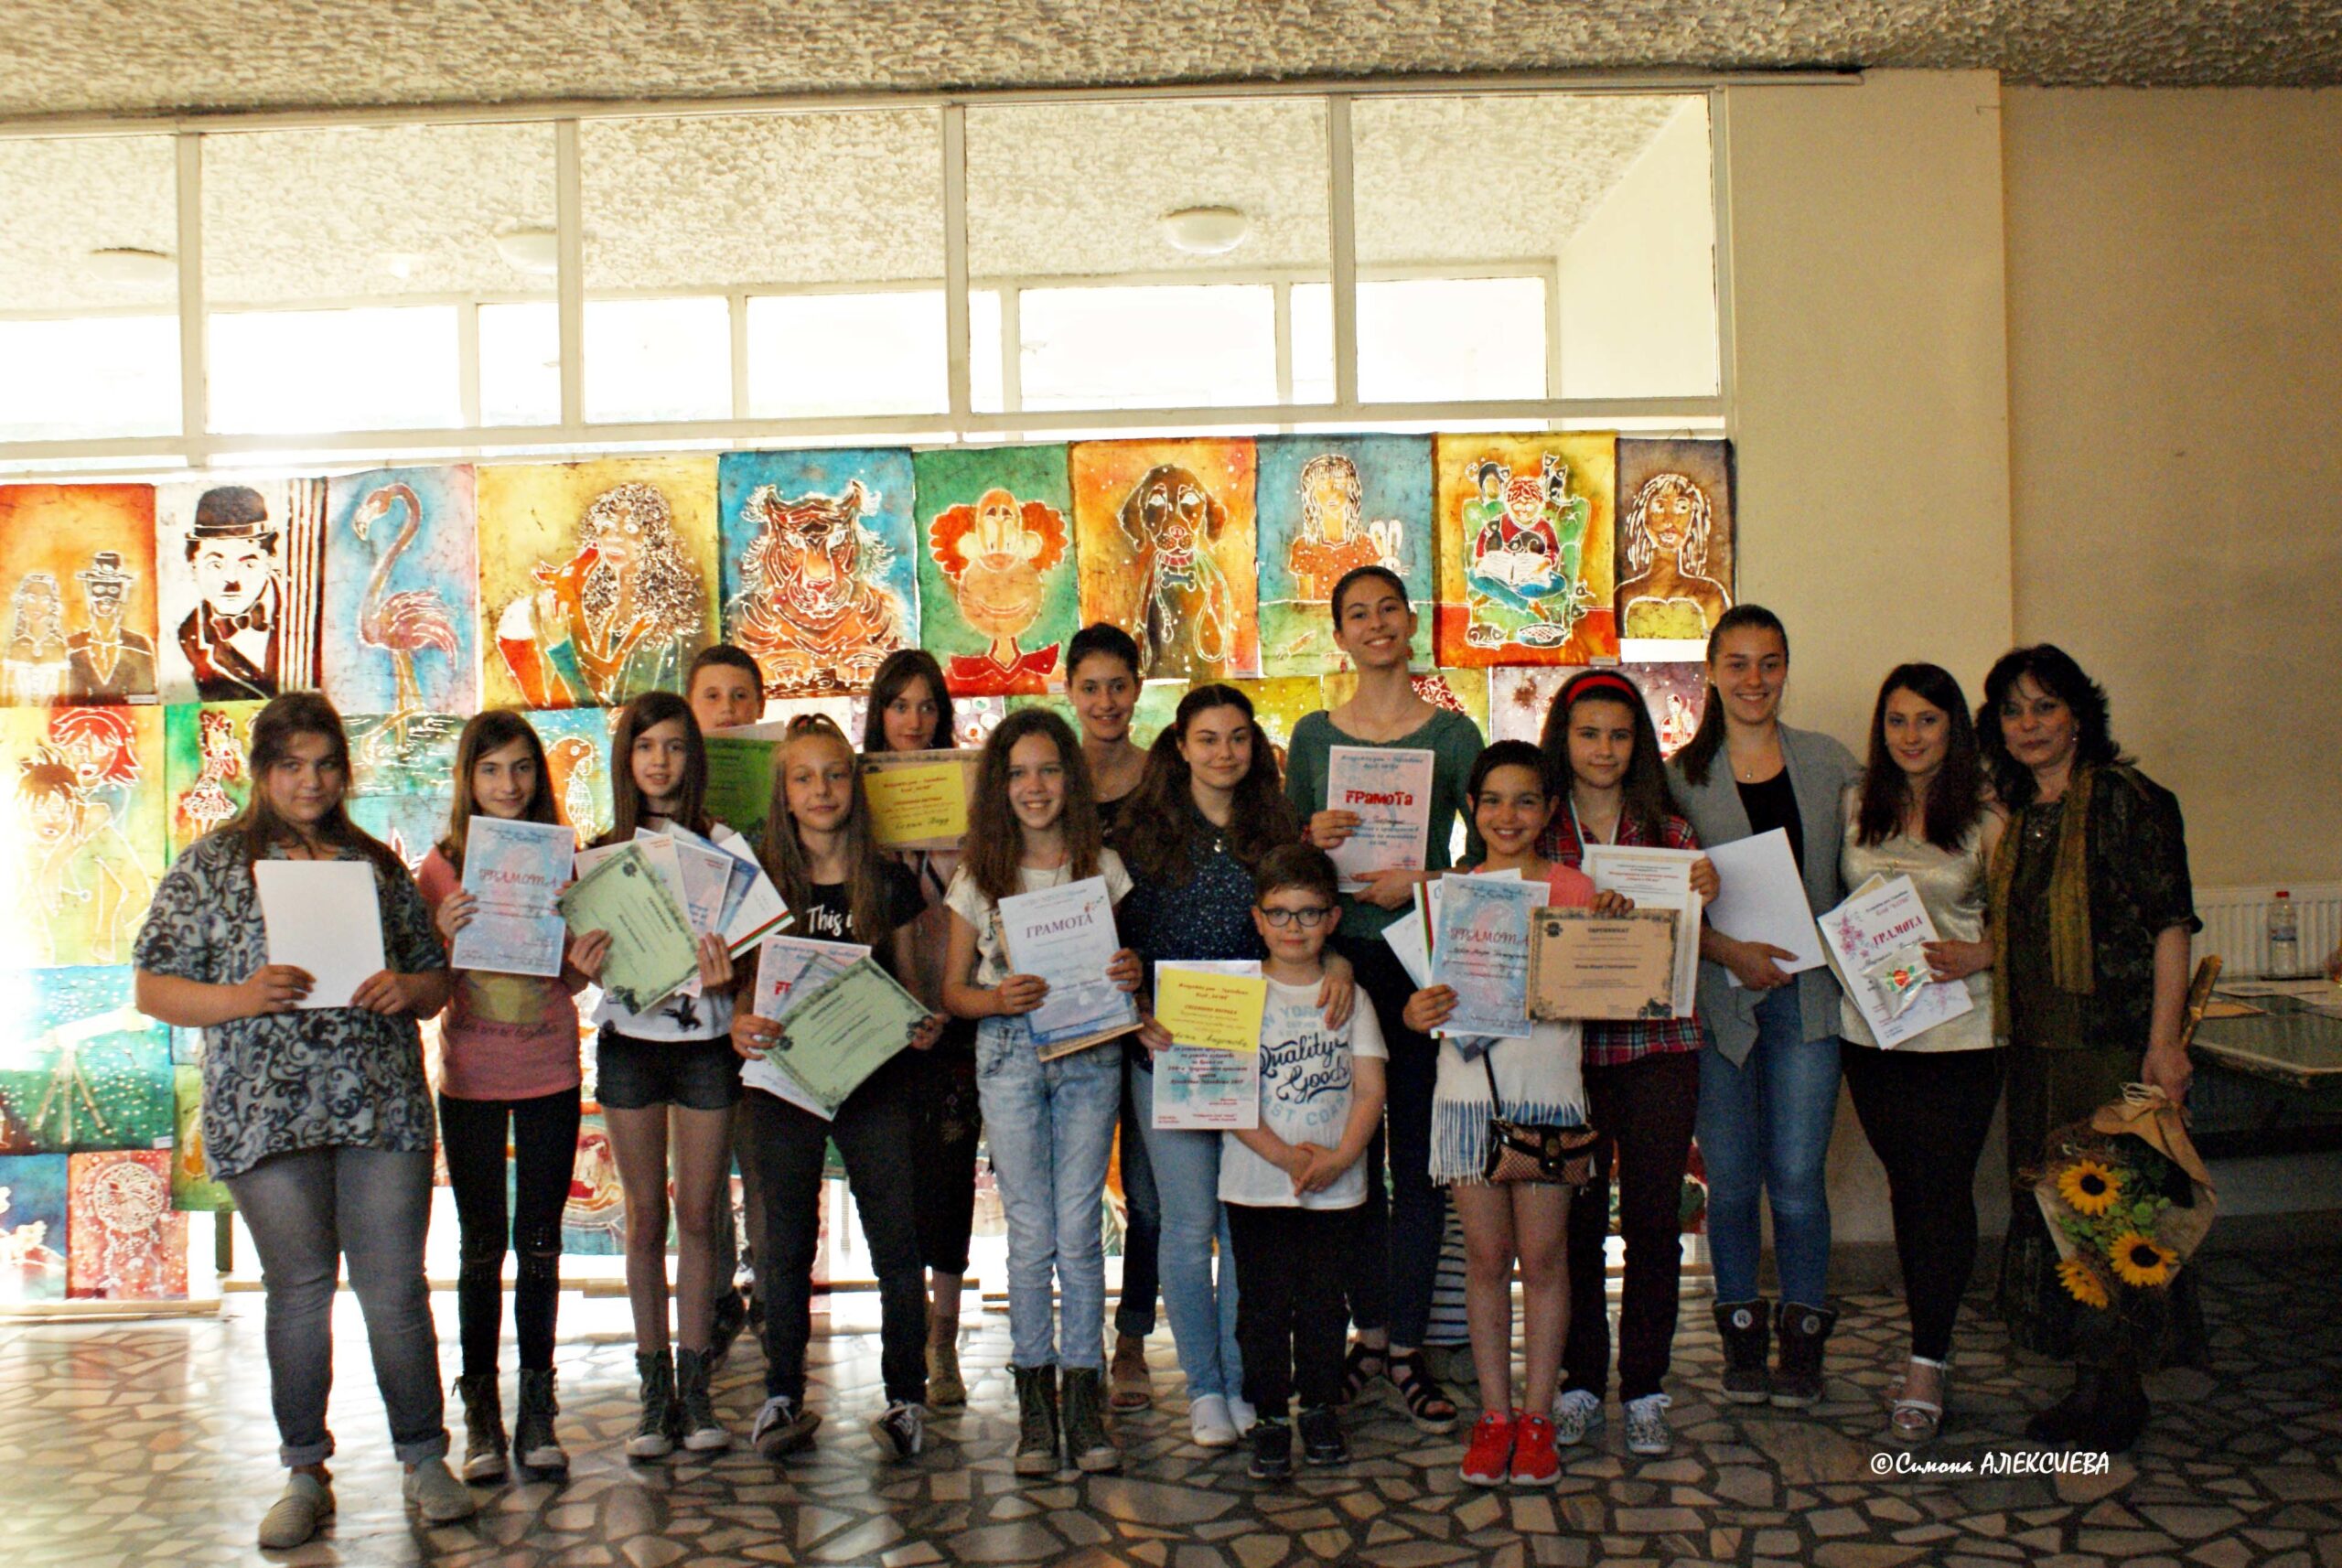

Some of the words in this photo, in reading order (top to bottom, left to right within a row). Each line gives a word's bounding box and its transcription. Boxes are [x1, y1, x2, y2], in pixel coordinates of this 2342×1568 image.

[806, 903, 843, 937] This
[845, 908, 855, 935] i
[1026, 913, 1094, 939] ГРАМОТА
[1260, 1032, 1349, 1079] Quality
